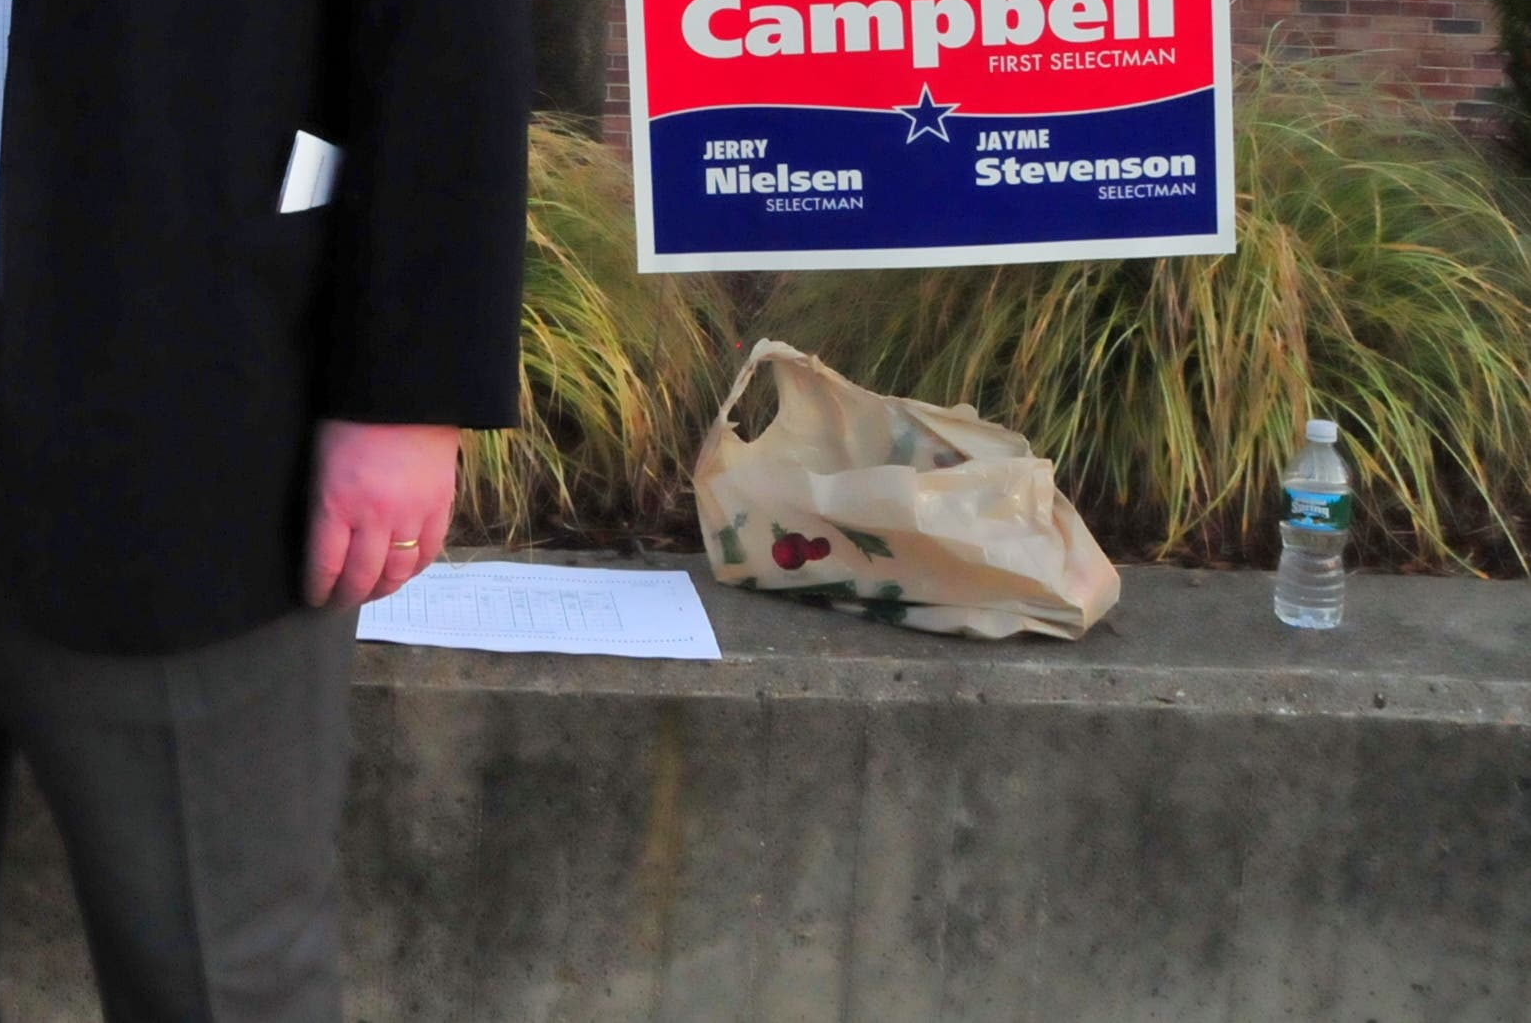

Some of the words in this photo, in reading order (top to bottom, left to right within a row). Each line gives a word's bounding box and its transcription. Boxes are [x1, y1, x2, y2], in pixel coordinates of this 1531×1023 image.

[988, 54, 1043, 74] FIRST
[1050, 47, 1177, 72] SELECTMAN
[703, 139, 768, 161] JERRY
[976, 128, 1051, 152] JAYME
[705, 163, 864, 195] Nielsen
[974, 154, 1196, 187] Stevenson
[1098, 182, 1197, 201] SELECTMAN
[765, 196, 865, 213] SELECTMAN
